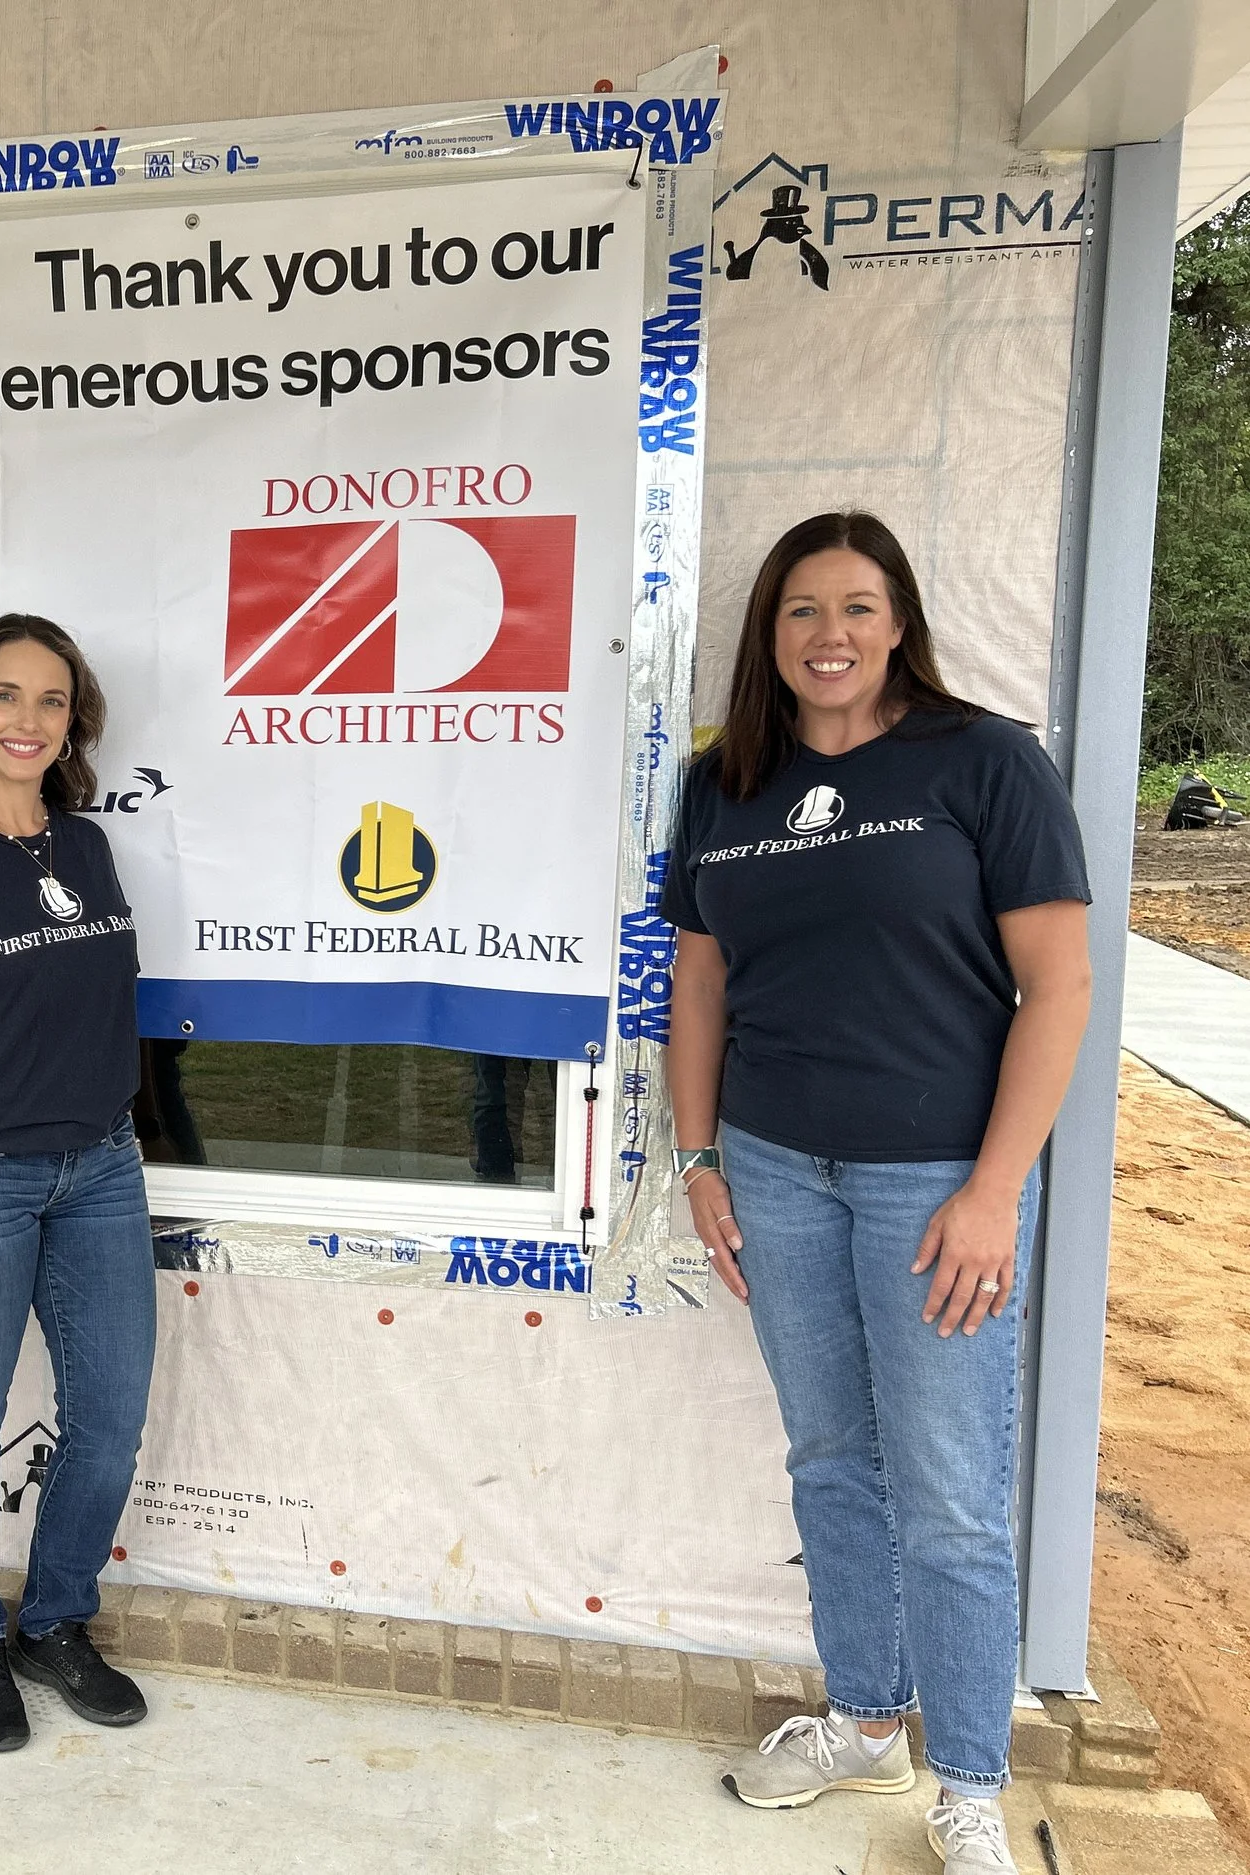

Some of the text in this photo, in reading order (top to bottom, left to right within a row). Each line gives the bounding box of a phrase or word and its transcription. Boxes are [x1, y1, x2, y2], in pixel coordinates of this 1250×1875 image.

[504, 98, 720, 138] WINDOW
[355, 130, 422, 154] mfm
[458, 135, 493, 143] PRODUCTS
[404, 147, 476, 159] 800.882.7663
[571, 129, 713, 164] WRAP
[655, 170, 665, 220] 882.7663
[668, 198, 676, 237] PRODUCTS
[34, 222, 614, 313] Thank you to our
[850, 259, 909, 270] WATER
[918, 251, 1023, 265] RESISTANT
[1031, 249, 1062, 259] AIR
[280, 328, 610, 407] sponsors
[662, 244, 704, 456] WINDOW
[638, 314, 669, 453] WRAP
[261, 464, 532, 517] DONOFRO
[222, 704, 565, 745] ARCHITECTS
[634, 752, 645, 822] 800.882.7663
[754, 829, 852, 856] FEDERAL
[856, 817, 924, 837] BANK
[41, 921, 109, 944] FEDERAL
[107, 915, 135, 931] BAN
[195, 920, 584, 964] FIRST FEDERAL BANK
[617, 910, 646, 1040] WRAP
[444, 1253, 592, 1293] NDOW
[133, 1497, 248, 1519] 800-647-6130
[174, 1484, 272, 1506] PRODUCTS,
[279, 1496, 314, 1509] INC.
[146, 1516, 175, 1525] ESR
[193, 1521, 235, 1533] 2514
